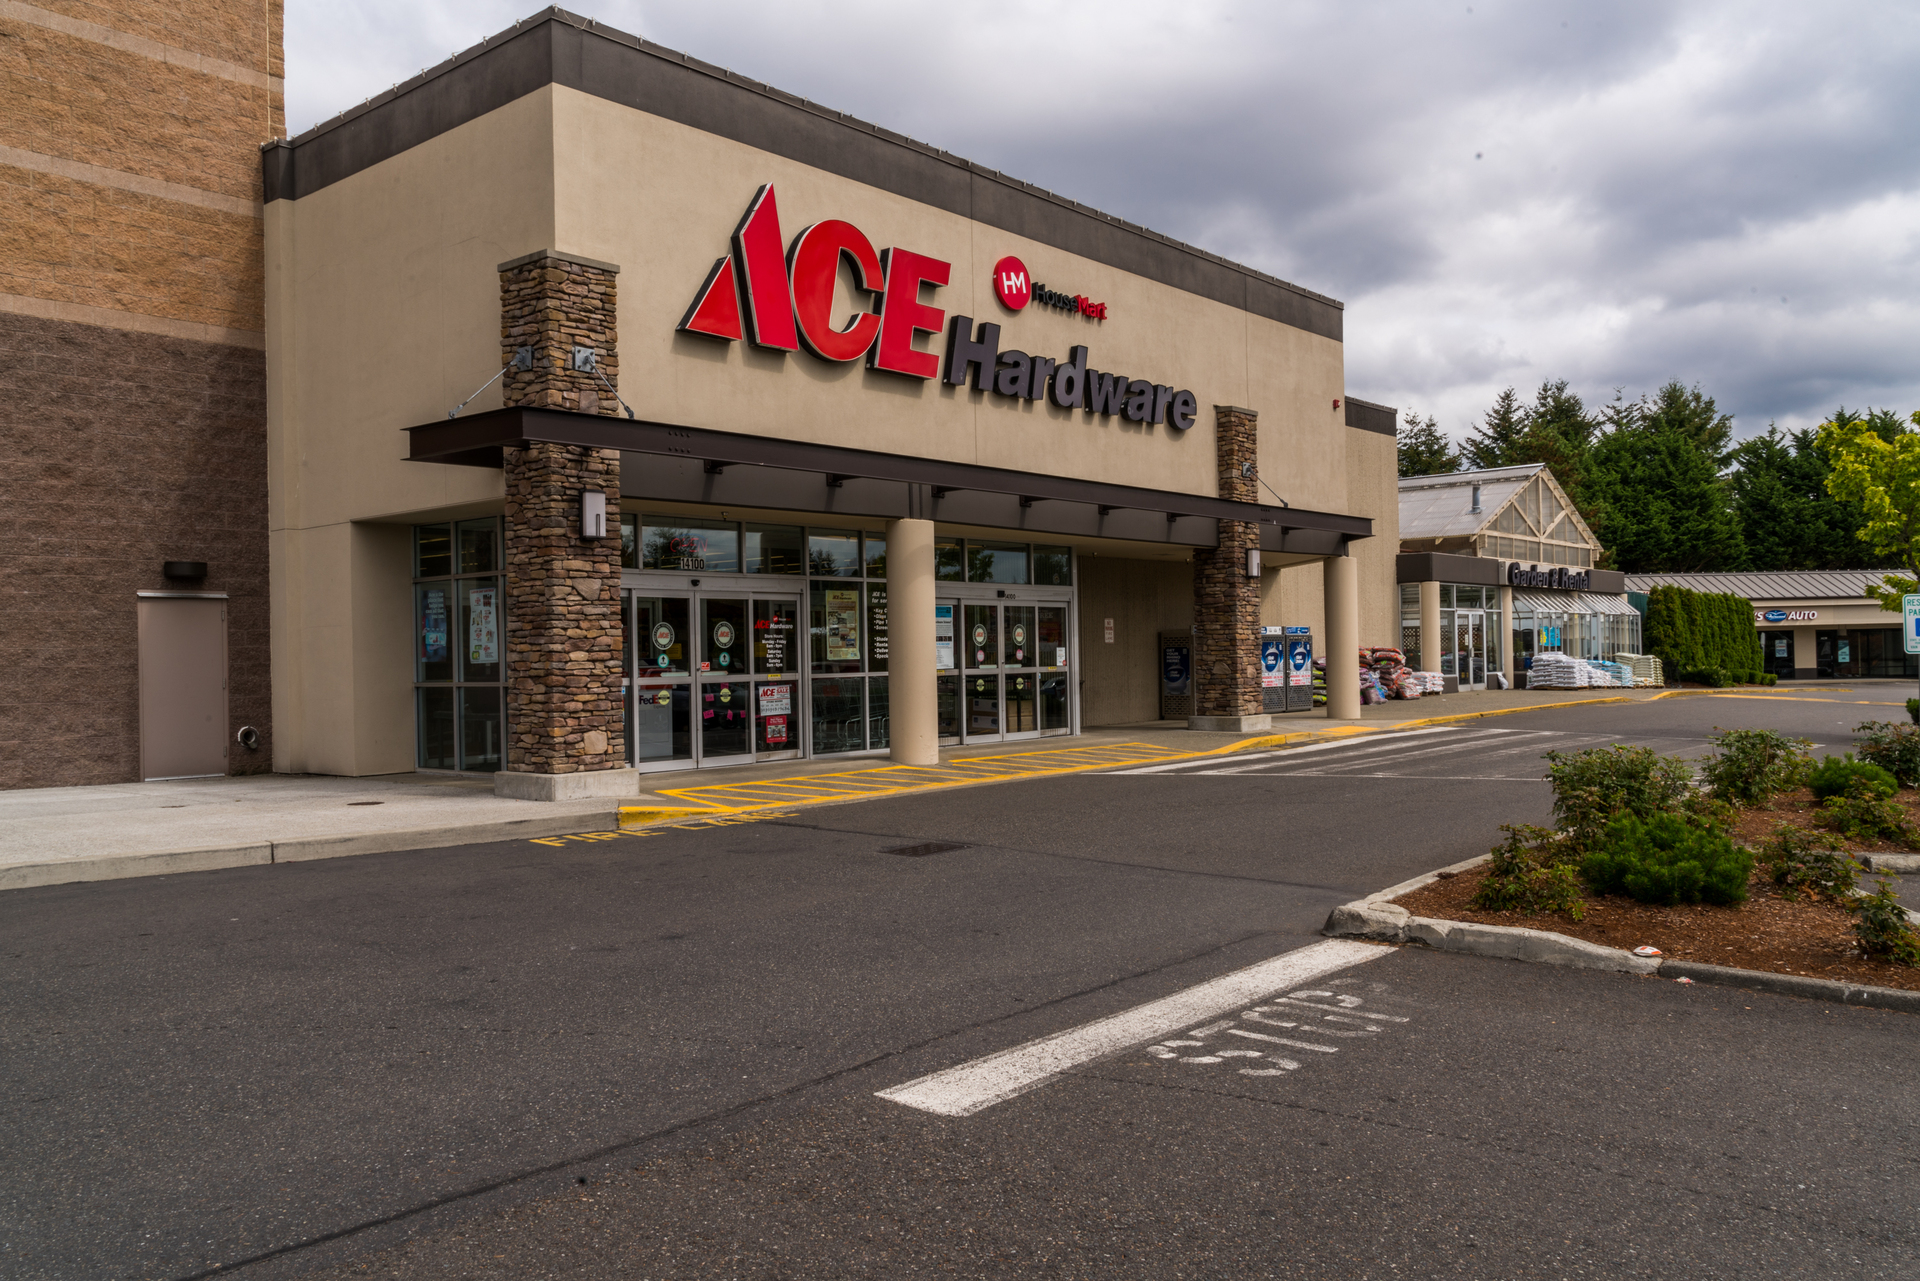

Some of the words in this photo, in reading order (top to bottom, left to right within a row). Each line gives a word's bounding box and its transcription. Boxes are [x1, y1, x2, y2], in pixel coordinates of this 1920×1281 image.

[676, 182, 951, 379] ACE
[1002, 271, 1026, 295] HM
[1031, 281, 1108, 321] HouseMart
[943, 315, 1197, 430] Hardware
[670, 537, 708, 552] OPEN
[681, 558, 705, 569] 14100
[1508, 562, 1549, 587] Garden
[1558, 568, 1592, 590] Rental
[1787, 611, 1818, 620] AUTO
[754, 619, 770, 629] ACE
[657, 631, 669, 639] ACE
[718, 629, 730, 638] ACE
[639, 694, 660, 705] FedE
[760, 688, 775, 697] ACE
[528, 827, 667, 848] FIRE
[670, 810, 801, 832] LANE
[1146, 989, 1409, 1077] STOP
